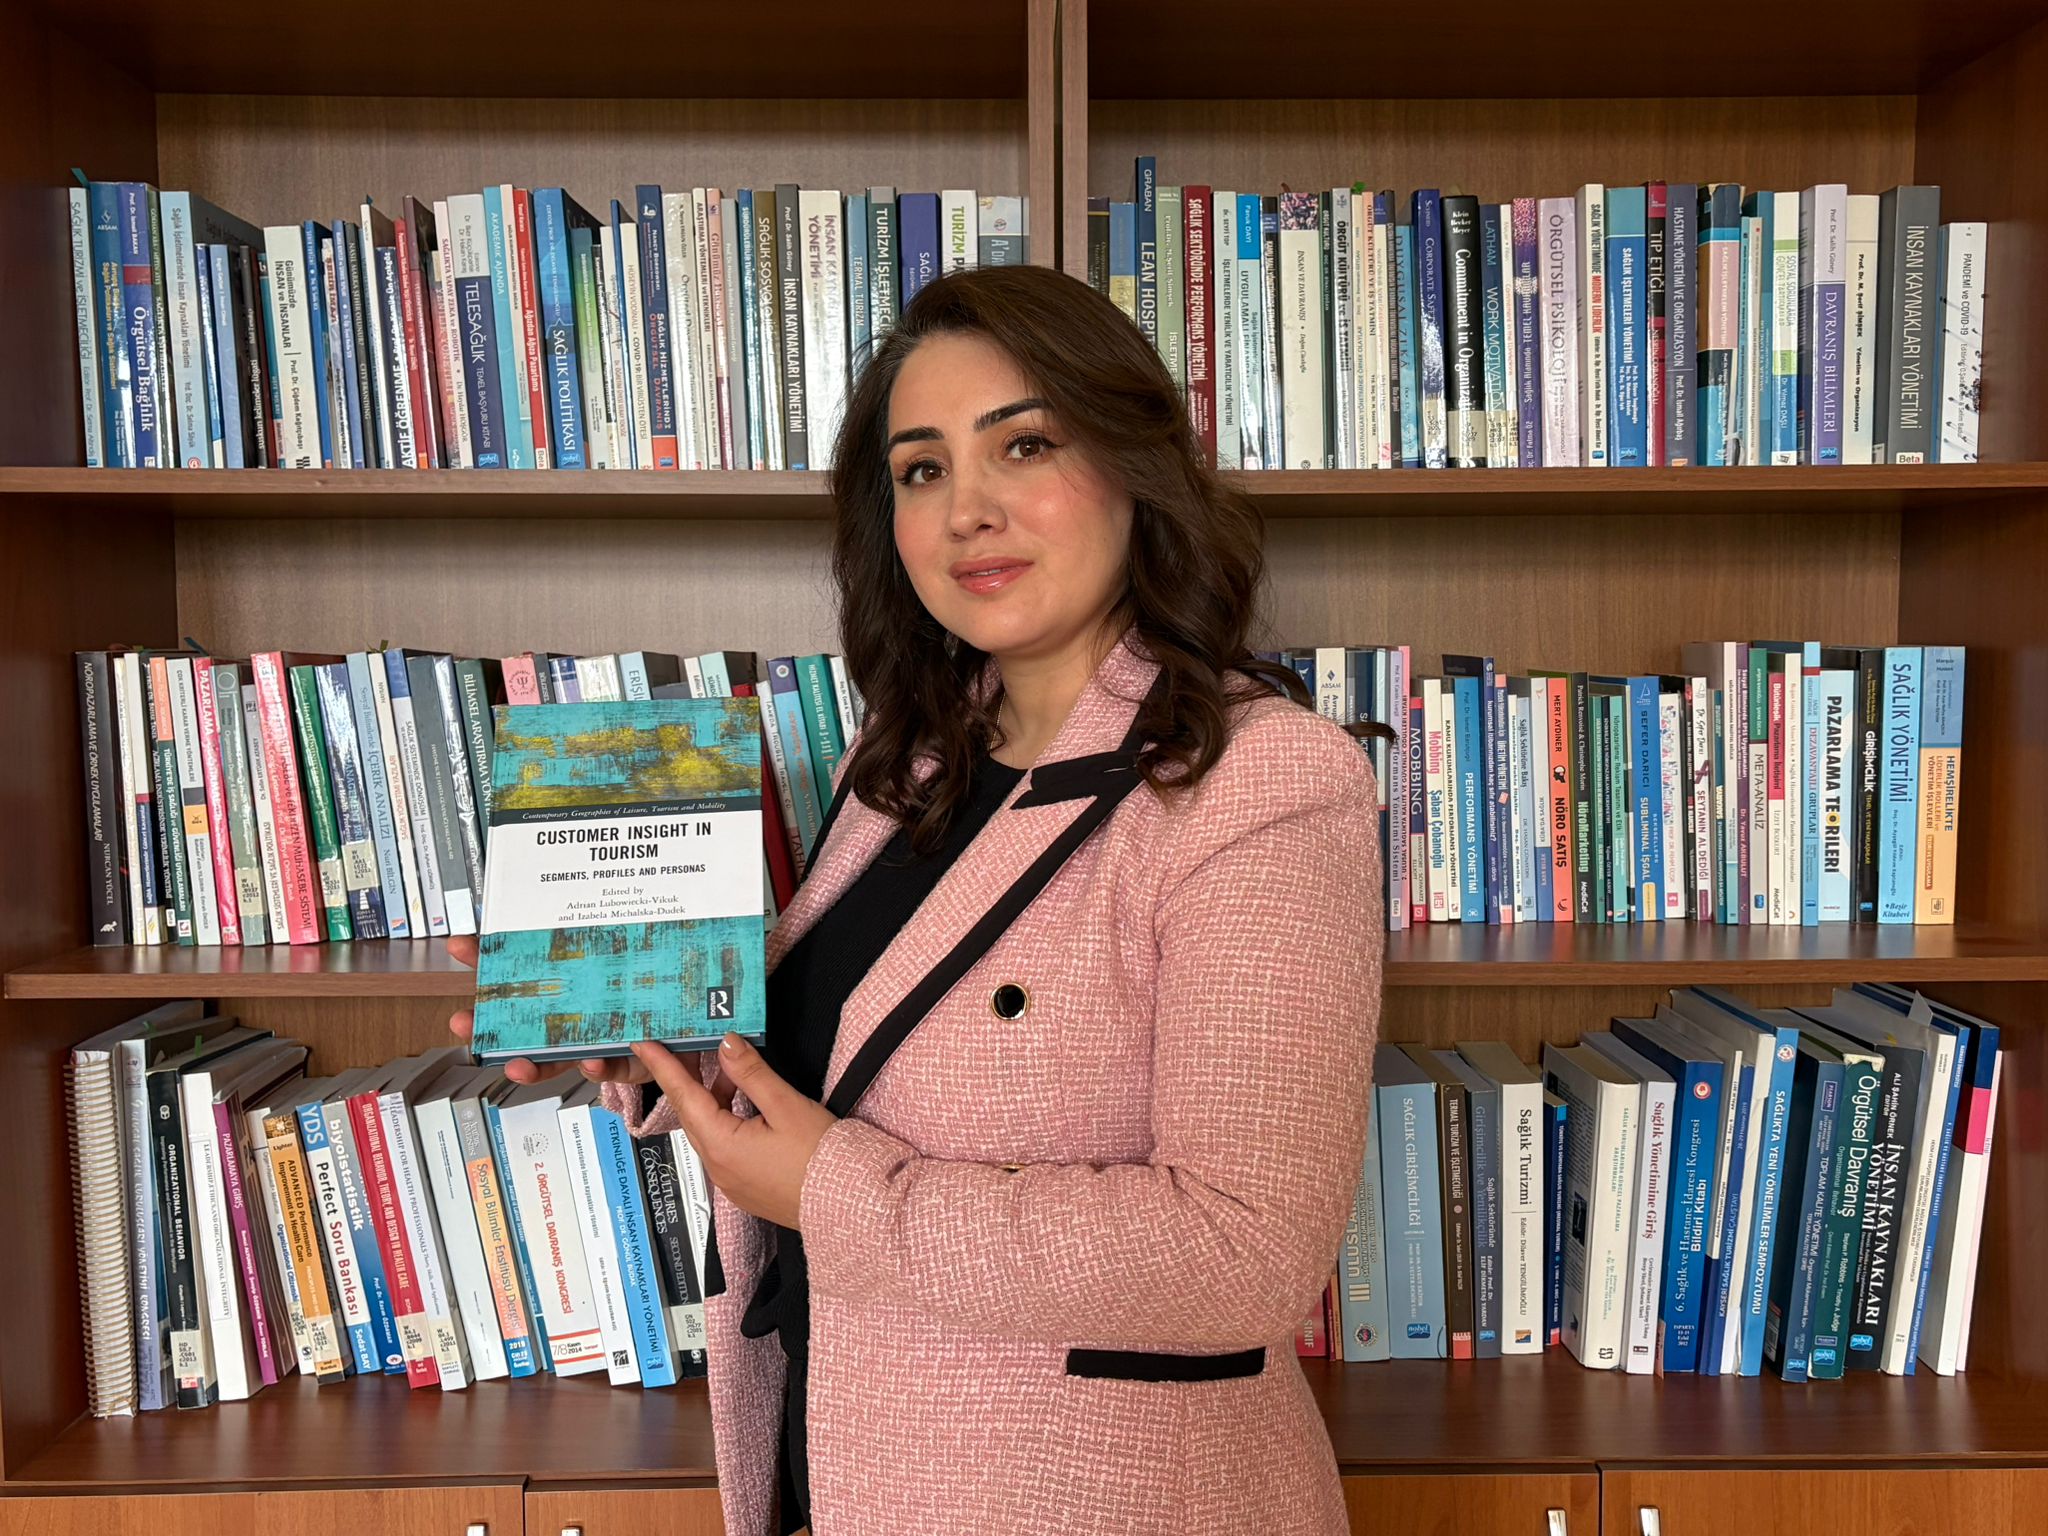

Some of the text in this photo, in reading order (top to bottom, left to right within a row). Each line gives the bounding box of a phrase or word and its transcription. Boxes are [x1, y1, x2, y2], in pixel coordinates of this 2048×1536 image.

[1141, 169, 1155, 282] GRABAN LEAN
[1591, 204, 1602, 333] SAĞLIK YÖNETİMİNDE MODERN LİDERLİK
[1650, 231, 1664, 292] TIP ETİĞİ
[70, 202, 90, 360] SAĞLIK TURİZMİ ve İŞLETMECİLİĞİ
[275, 261, 292, 348] İNSAN ve İNSANLAR
[284, 260, 297, 308] Günümüzde
[854, 256, 864, 326] TERMAL TURİZM
[1189, 198, 1209, 380] SAĞLIK SEKTÖRÜNDE PERFORMANS YÖNETİMİ
[1222, 259, 1233, 314] İŞLETMELERDE
[1485, 220, 1502, 411] LATHAM WORK MOTIVATION
[1621, 248, 1635, 363] SAĞLIK İŞLETMELERİ YÖNETİMİ
[1674, 207, 1684, 366] HASTANE YÖNETİMİ VE ORGANİZASYON
[1960, 254, 1973, 335] PANDEMİ ve COVID-19
[129, 307, 152, 431] Örgütsel Bağlılık
[465, 282, 486, 364] TELESAĞLIK
[476, 368, 486, 388] TEMEL
[552, 330, 569, 377] SAĞLIK
[784, 278, 806, 432] İNSAN KAYNAKLARI YÖNETİMİ
[1224, 316, 1233, 337] YENİLİK
[1225, 339, 1232, 348] VE
[1822, 292, 1838, 432] DAVRANIŞ BİLİMLERİ
[1900, 226, 1928, 428] İNSAN KAYNAKLARI YÖNETİMİ
[557, 380, 575, 450] POLİTİKASI
[1225, 393, 1234, 426] YÖNETİMİ
[1553, 695, 1562, 716] MERT
[1891, 664, 1915, 719] SAĞLIK
[88, 741, 98, 750] VE
[1410, 728, 1422, 814] MOBBING
[1808, 728, 1818, 834] DEZAVANTAJLI GRUPLAR
[1824, 696, 1842, 872] PAZARLAMA TEORİLERİ
[1889, 724, 1914, 802] YÖNETİMİ
[1926, 756, 1934, 790] YÖNETİM
[367, 750, 390, 840] İÇERİK ANALİZİ
[523, 811, 568, 820] Contemporary
[537, 822, 711, 846] CUSTOMER INSIGHT IN
[1426, 731, 1444, 868] Mobbing Şaban Çobanoğlu
[1464, 773, 1478, 894] PERFORMANS YÖNETİMİ
[1555, 798, 1566, 829] NÖRO
[1695, 790, 1709, 880] ŞEYTANIN AL DEDİĞİ
[1754, 754, 1766, 830] META-ANALİZ
[1944, 756, 1956, 831] HEMŞİRELİKTE
[103, 843, 114, 905] NURCAN YÜCEL
[540, 864, 706, 882] SEGMENTS, PROFILES AND PERSONAS
[590, 844, 658, 861] TOURISM
[1555, 835, 1567, 867] SATIŞ
[1578, 801, 1590, 872] NöroMarketing
[1640, 797, 1652, 880] SUBLIMINAL İŞGAL
[558, 906, 685, 921] and Izabela Michalska-Dudek
[600, 896, 679, 907] Lubowiecki-Vikuk
[602, 887, 643, 896] Edited by
[301, 1105, 324, 1145] YDS
[1403, 1098, 1420, 1226] SAĞLIK GİRİŞİMCİLİĞİ
[1517, 1109, 1532, 1205] Sağlık Turizmi
[1838, 1075, 1881, 1217] Örgütsel Davranış
[168, 1144, 186, 1260] ORGANIZATIONAL BEHAVIOR
[222, 1133, 243, 1209] PAZARLAMAYA GİRİŞ
[328, 1119, 364, 1231] biyoistatistik
[1643, 1102, 1665, 1239] Sağlık Yönetimine Giriş
[1752, 1090, 1786, 1314] SAĞLIKTA YENİ YÖNELİMLER SEMPOZYUMU
[1861, 1142, 1884, 1230] YÖNETİMİ
[316, 1162, 359, 1315] Perfect Soru Bankası
[534, 1162, 574, 1314] 2. ÖRGÜTSEL DAVRANIŞ KONGRESİ
[608, 1120, 661, 1352] YETKİNLİĞE DAYALI İNSAN KAYNAKLARI YÖNETİMİ
[1865, 1144, 1904, 1325] İNSAN KAYNAKLARI
